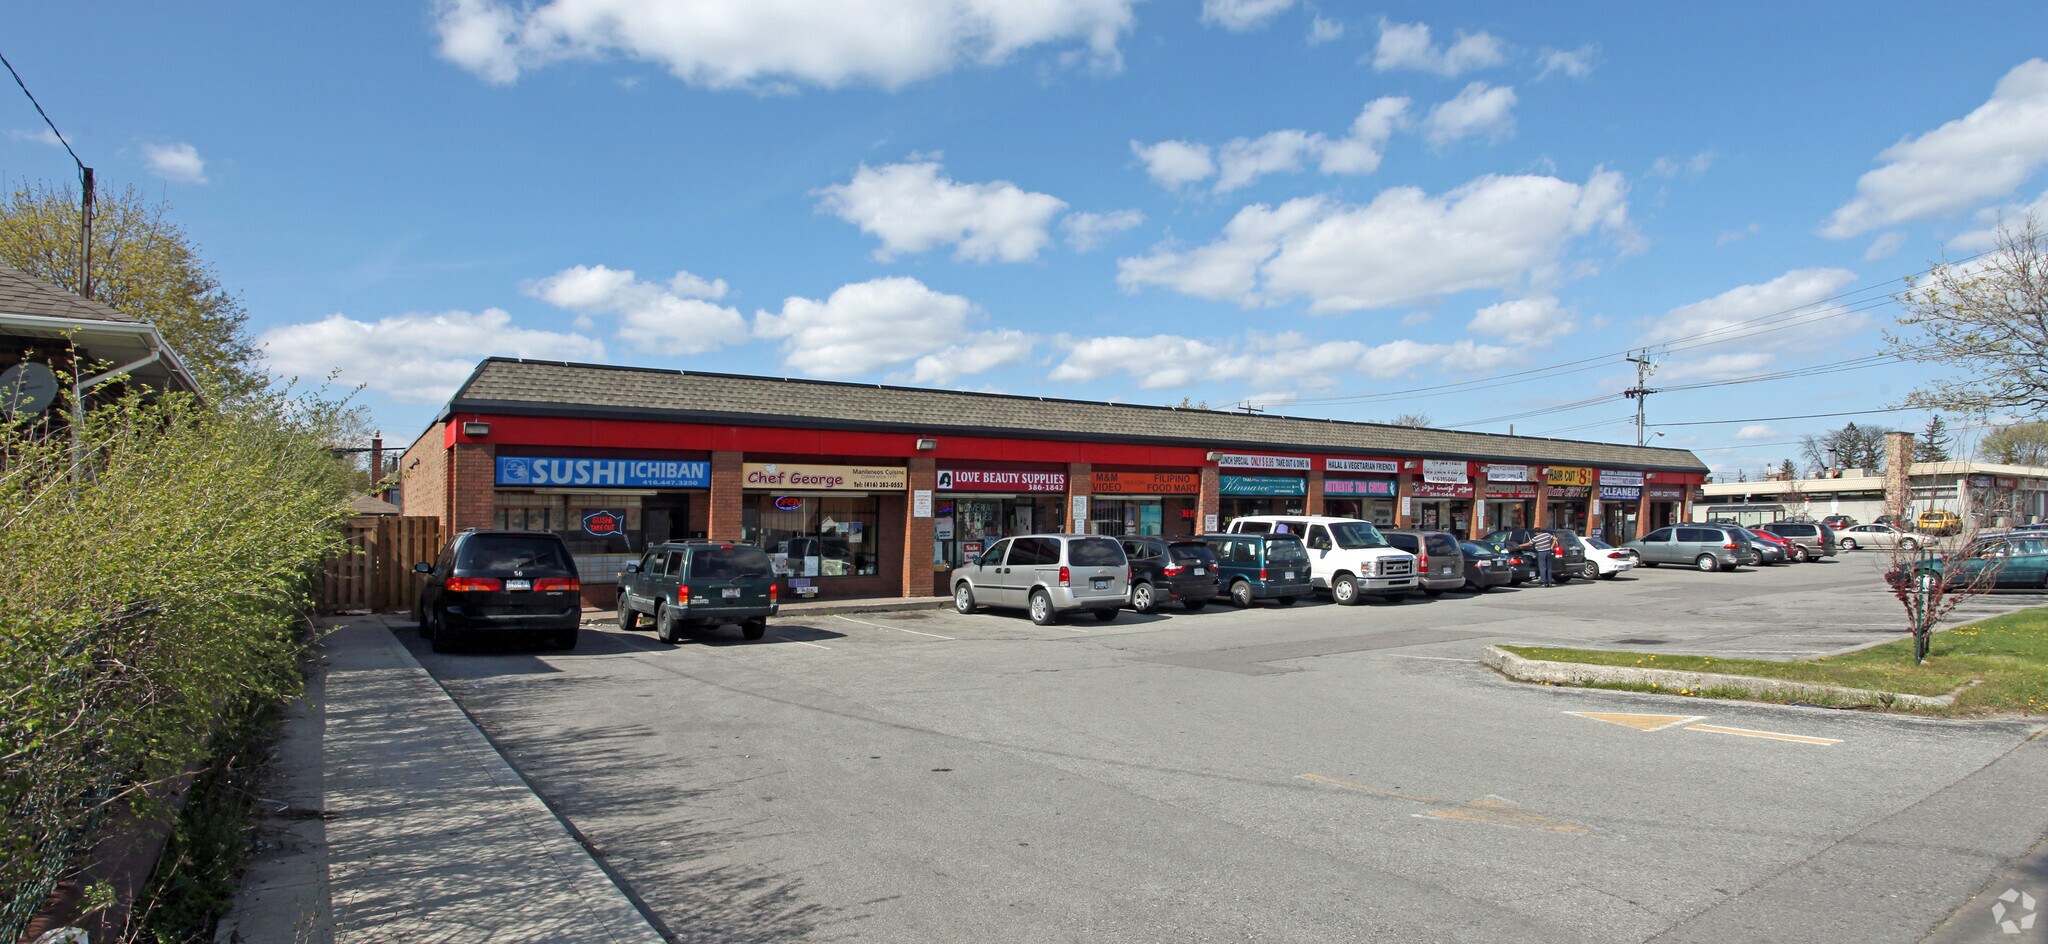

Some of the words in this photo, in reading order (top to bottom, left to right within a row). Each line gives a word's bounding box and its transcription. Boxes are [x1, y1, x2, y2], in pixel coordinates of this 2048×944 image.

[1234, 457, 1249, 466] SPECIAL
[1250, 457, 1262, 466] ONLY
[1276, 458, 1285, 467] TAKE
[1297, 459, 1305, 468] DINE
[1328, 461, 1342, 469] HALAL
[1344, 461, 1347, 469] &
[1348, 461, 1376, 470] VEGETARIAN
[1376, 462, 1396, 471] FRIENDLY
[532, 459, 626, 485] SUSHI
[630, 462, 704, 479] ICHIBAN
[1564, 470, 1576, 482] CUT
[748, 471, 786, 484] Chef
[790, 472, 844, 488] George
[956, 471, 980, 483] LOVE
[983, 472, 1020, 484] BEAUTY
[1021, 473, 1064, 485] SUPPLIES
[1096, 473, 1118, 482] M&M
[1154, 475, 1190, 483] FILIPINO
[1092, 482, 1122, 492] VIDEO
[1147, 484, 1172, 492] FOOD
[1174, 484, 1197, 492] MART
[1324, 480, 1354, 493] AUTHENTIC
[1356, 481, 1366, 493] THAI
[1368, 482, 1388, 494] CUISINE
[1516, 485, 1535, 494] PIZZA
[1603, 487, 1640, 497] CLEANERS
